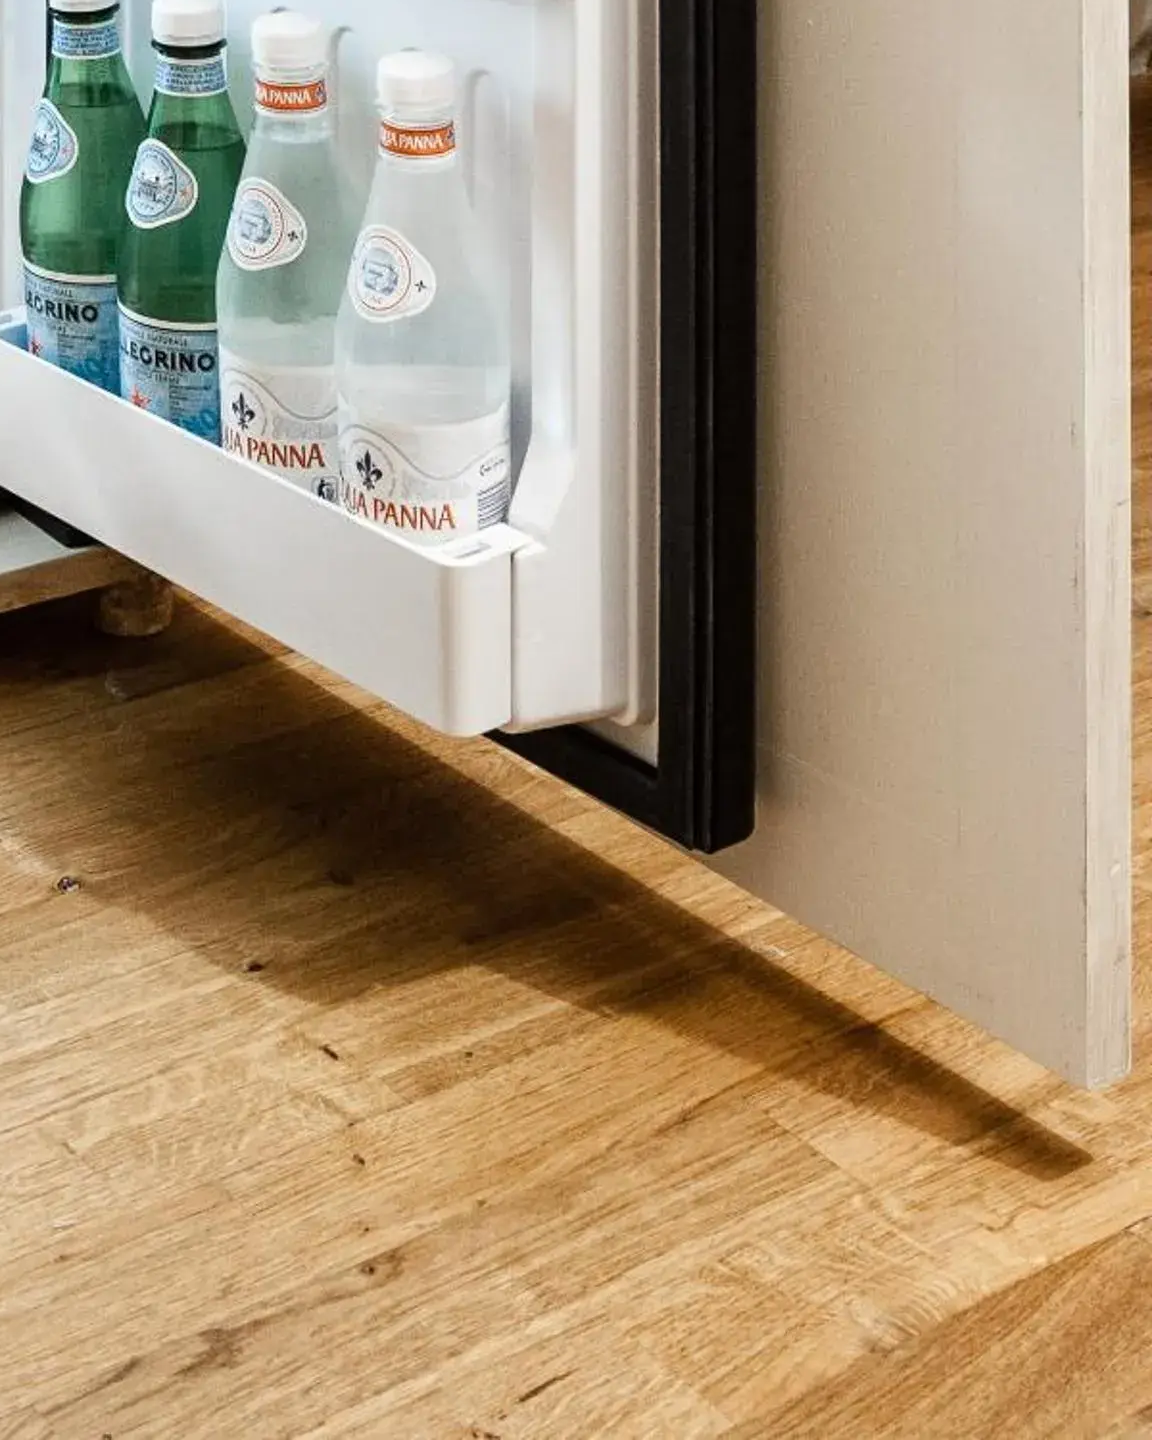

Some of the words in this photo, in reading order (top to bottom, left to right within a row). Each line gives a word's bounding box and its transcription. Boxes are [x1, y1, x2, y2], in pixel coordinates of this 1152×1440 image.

[269, 89, 312, 105] PANNA
[399, 131, 444, 150] PANNA
[247, 437, 325, 469] PANNA
[372, 496, 457, 531] PANNA
